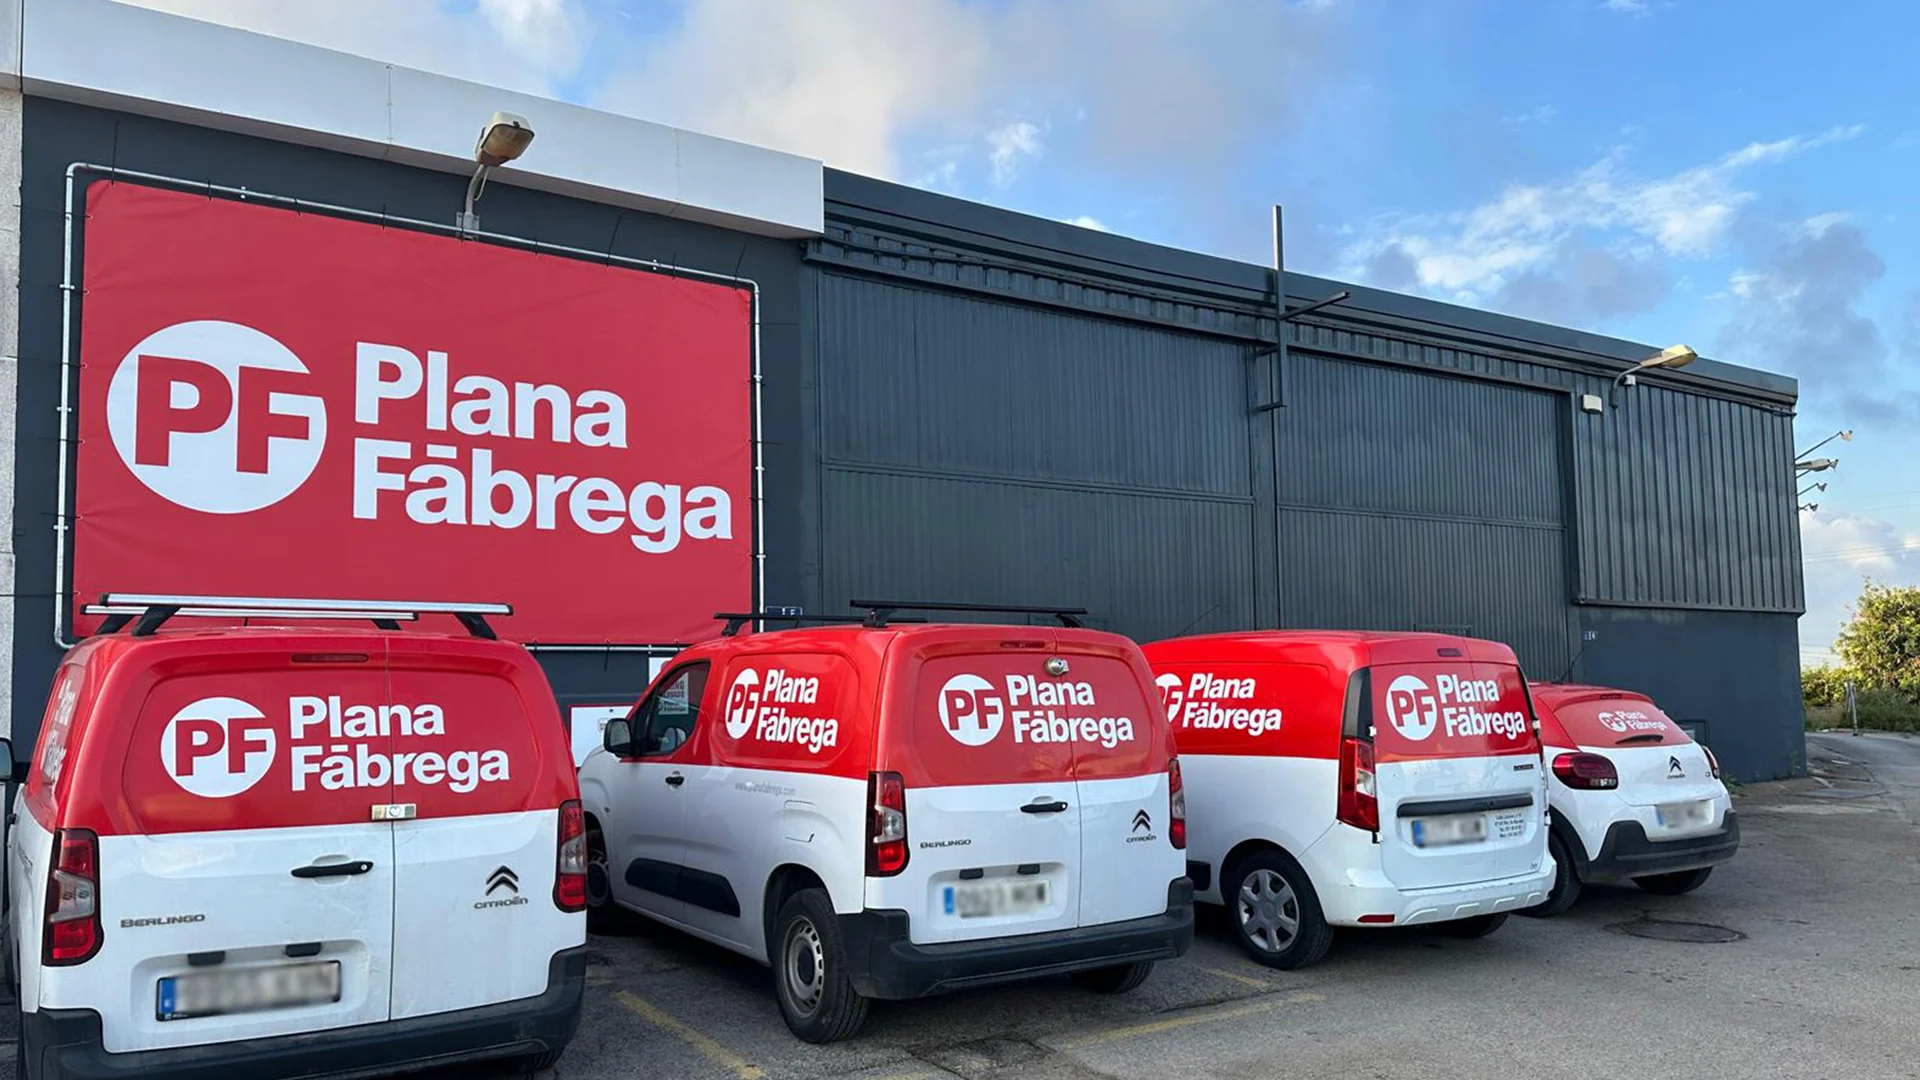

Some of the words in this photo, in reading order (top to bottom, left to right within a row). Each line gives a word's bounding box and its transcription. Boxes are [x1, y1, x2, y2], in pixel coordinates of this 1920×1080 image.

[133, 352, 326, 476] PF
[355, 341, 628, 449] Plana
[727, 682, 760, 724] PF
[762, 669, 819, 704] Plana
[1005, 674, 1096, 707] Plana
[1187, 673, 1256, 699] Plana
[1435, 673, 1500, 704] Plana
[289, 695, 445, 739] Plana
[943, 687, 1002, 733] PF
[1390, 687, 1437, 728] PF
[172, 715, 276, 779] PF
[920, 838, 971, 849] BERLINGO
[120, 914, 206, 928] BERLINGO
